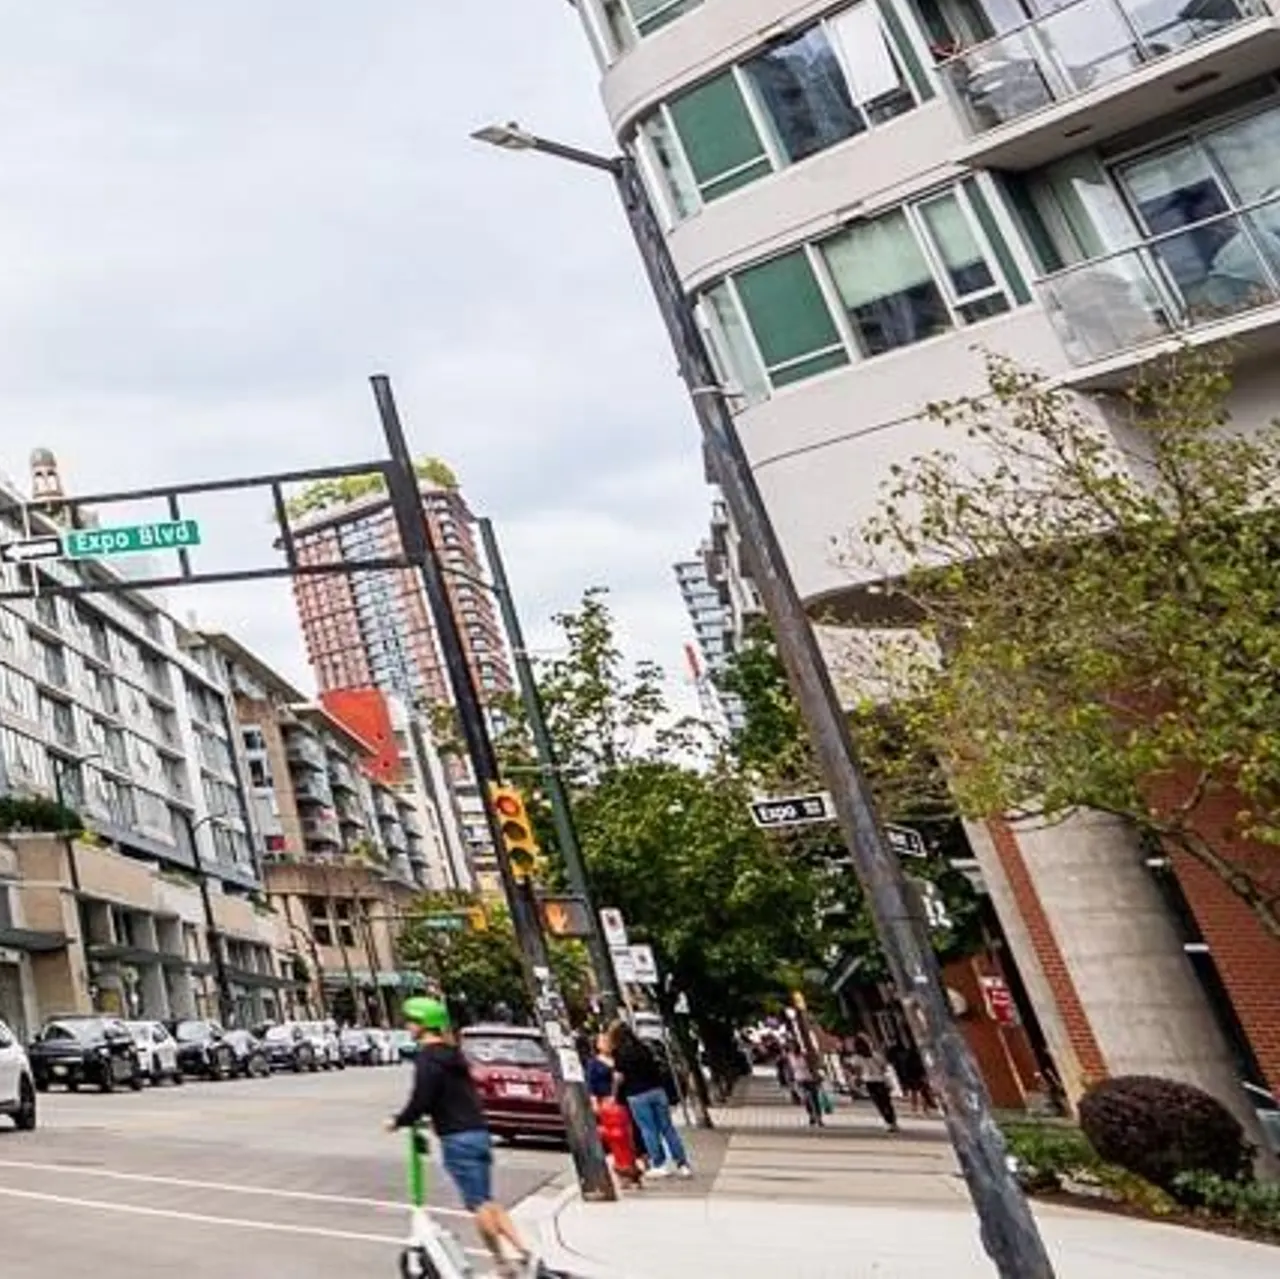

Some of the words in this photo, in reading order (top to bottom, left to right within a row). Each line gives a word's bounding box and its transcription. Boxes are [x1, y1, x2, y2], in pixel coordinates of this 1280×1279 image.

[76, 531, 129, 554] Expo
[140, 522, 190, 546] Blvd
[758, 803, 798, 822] Expo
